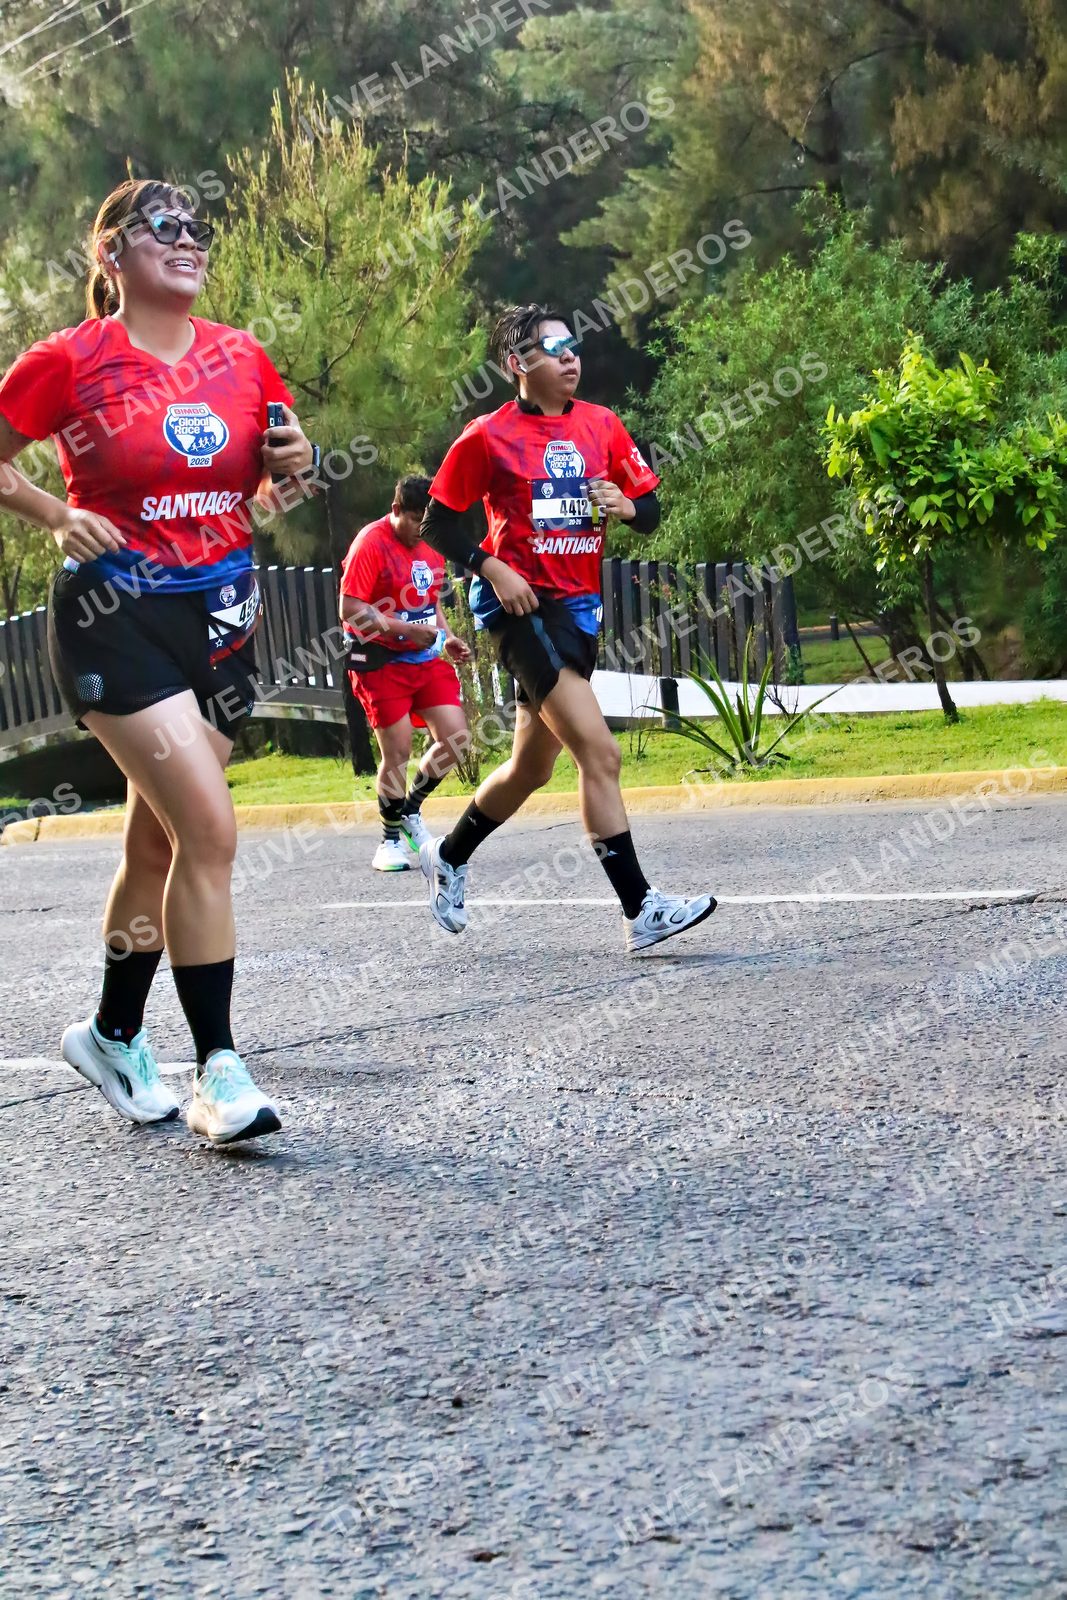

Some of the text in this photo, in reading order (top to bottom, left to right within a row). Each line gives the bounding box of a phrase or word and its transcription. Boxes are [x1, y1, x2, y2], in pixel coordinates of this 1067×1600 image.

[178, 417, 210, 427] Global
[174, 426, 201, 435] Race
[190, 458, 210, 466] 2026
[140, 491, 243, 521] SANTIAGO
[559, 499, 589, 516] 4412
[532, 535, 602, 555] SANTIAGO
